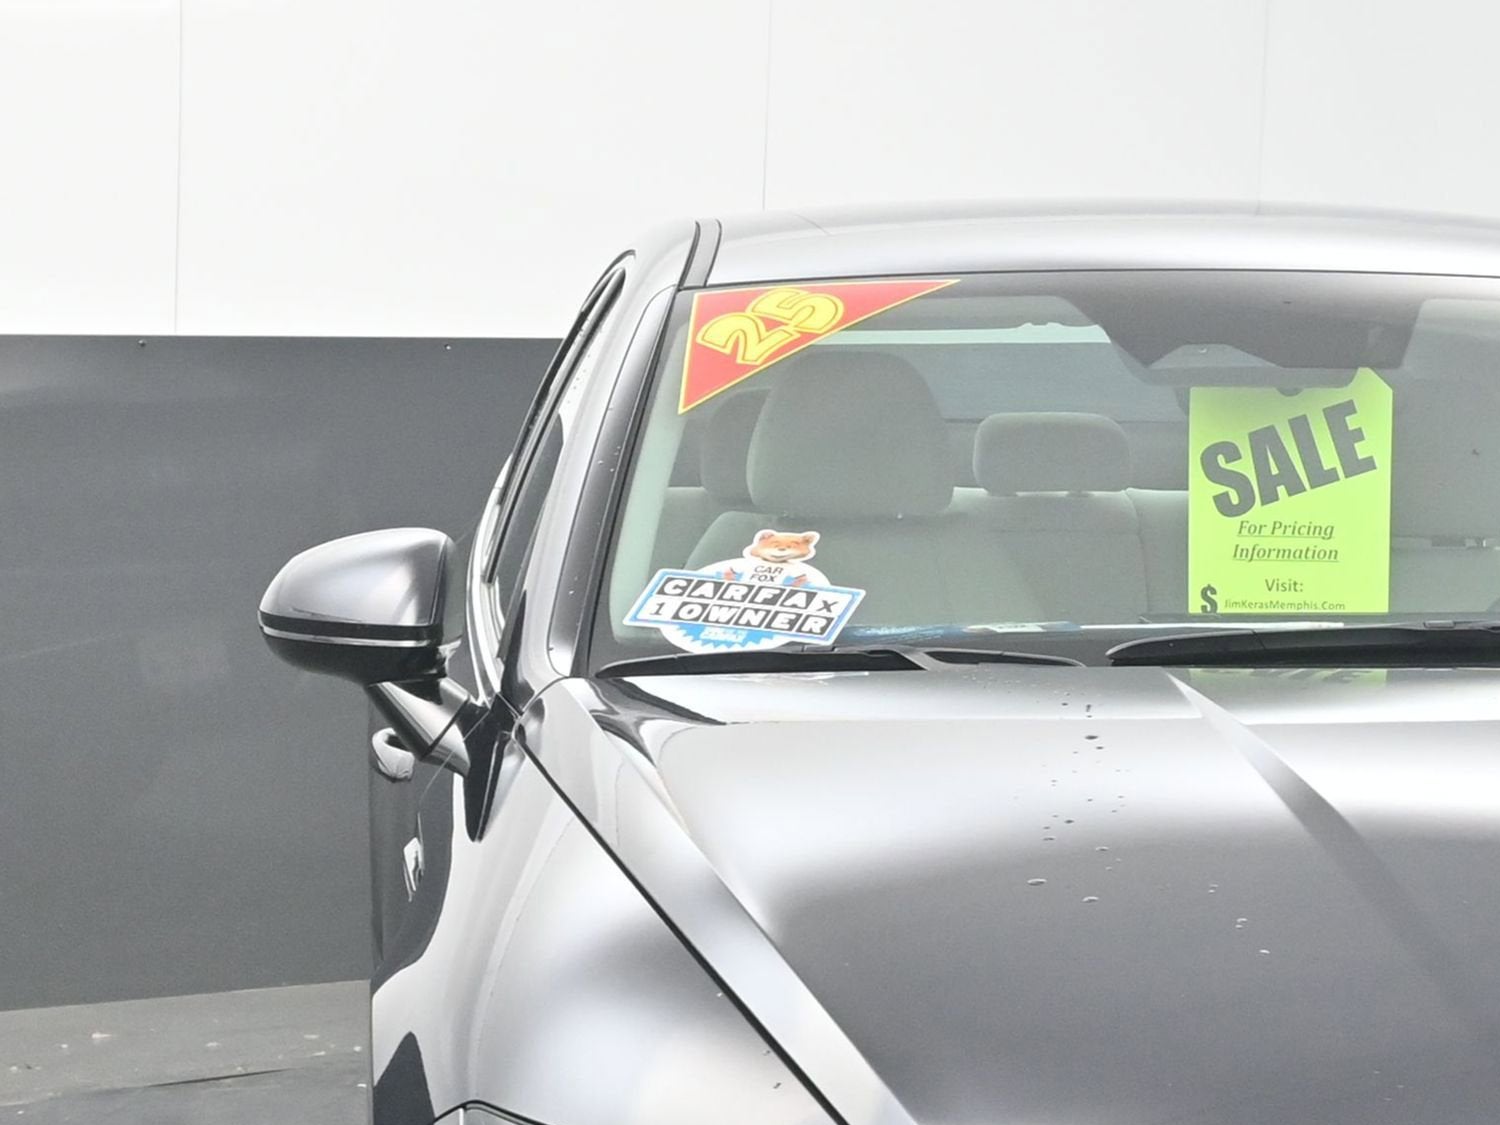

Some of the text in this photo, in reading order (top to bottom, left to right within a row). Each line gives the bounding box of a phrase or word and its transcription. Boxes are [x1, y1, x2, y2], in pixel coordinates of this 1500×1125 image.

[696, 287, 844, 365] 25
[1199, 399, 1377, 518] SALE
[1238, 520, 1335, 540] For Pricing
[1232, 543, 1339, 563] Information
[749, 574, 778, 582] FOX
[753, 565, 784, 574] CAR
[659, 578, 840, 613] CARFAX
[1265, 579, 1304, 593] Visit:
[1224, 599, 1346, 611] JimKerasMemphis.Com
[650, 601, 665, 616] 1
[675, 602, 826, 635] OWNER
